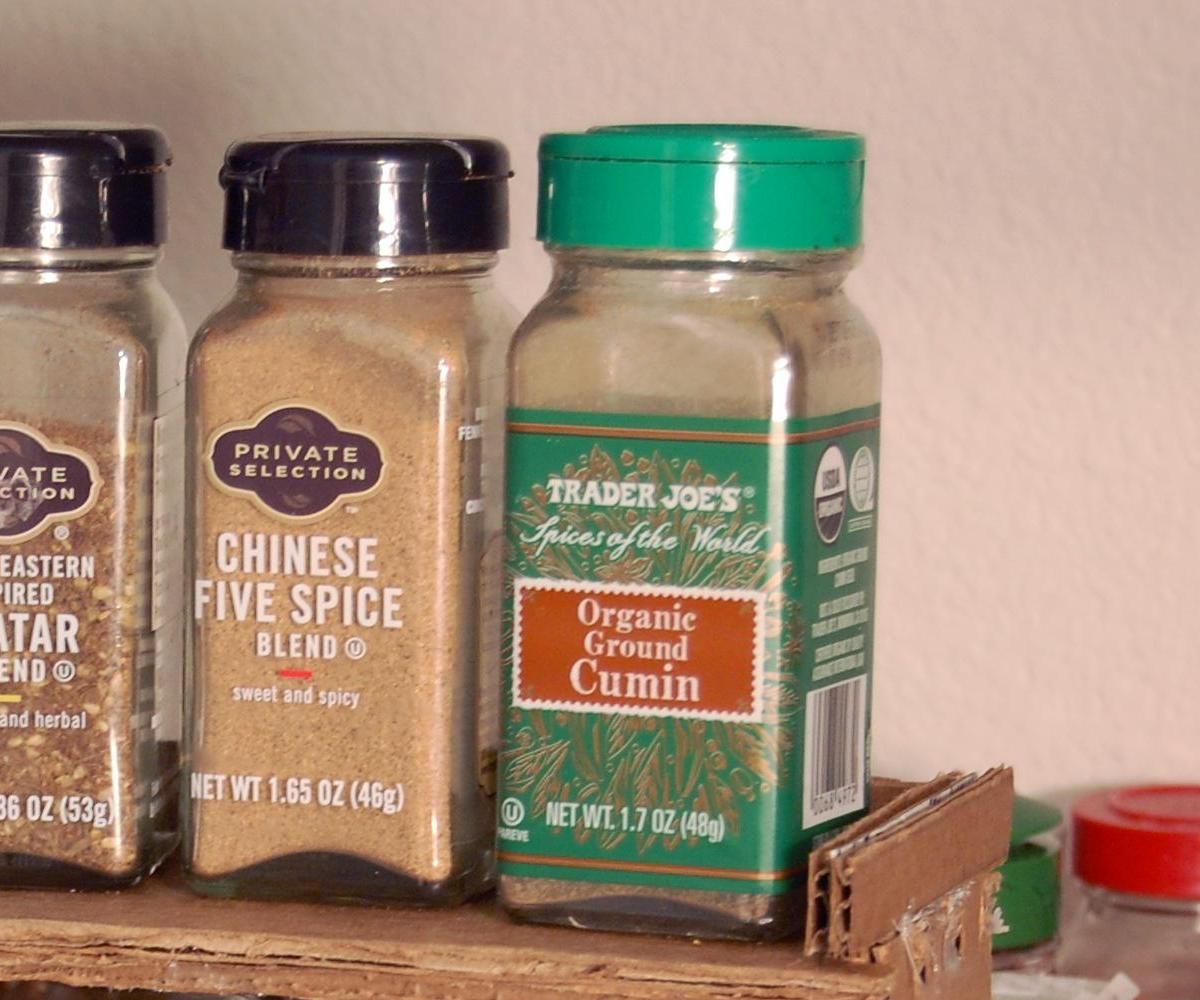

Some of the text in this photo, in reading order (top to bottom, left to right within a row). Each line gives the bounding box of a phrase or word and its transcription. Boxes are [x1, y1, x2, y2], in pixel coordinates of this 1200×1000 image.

[235, 443, 358, 463] PRIVATE
[230, 463, 366, 480] SELECTION
[546, 479, 658, 507] TRADER
[520, 514, 771, 560] Spices of the World
[0, 555, 94, 579] EASTERN
[216, 533, 378, 578] CHINESE
[194, 579, 403, 629] FIVE SPICE
[577, 598, 697, 632] Organic
[257, 632, 336, 659] BLEND
[584, 629, 689, 662] Ground
[570, 658, 701, 702] Cumin
[233, 685, 360, 709] sweet and spicy
[0, 710, 28, 728] and
[34, 710, 86, 729] herbal
[191, 772, 405, 813] NET WT 1.65 OZ (46g)
[28, 796, 53, 822] OZ
[60, 797, 115, 827] (53g)
[546, 802, 725, 842] NET WT. 1.7 OZ (48g)
